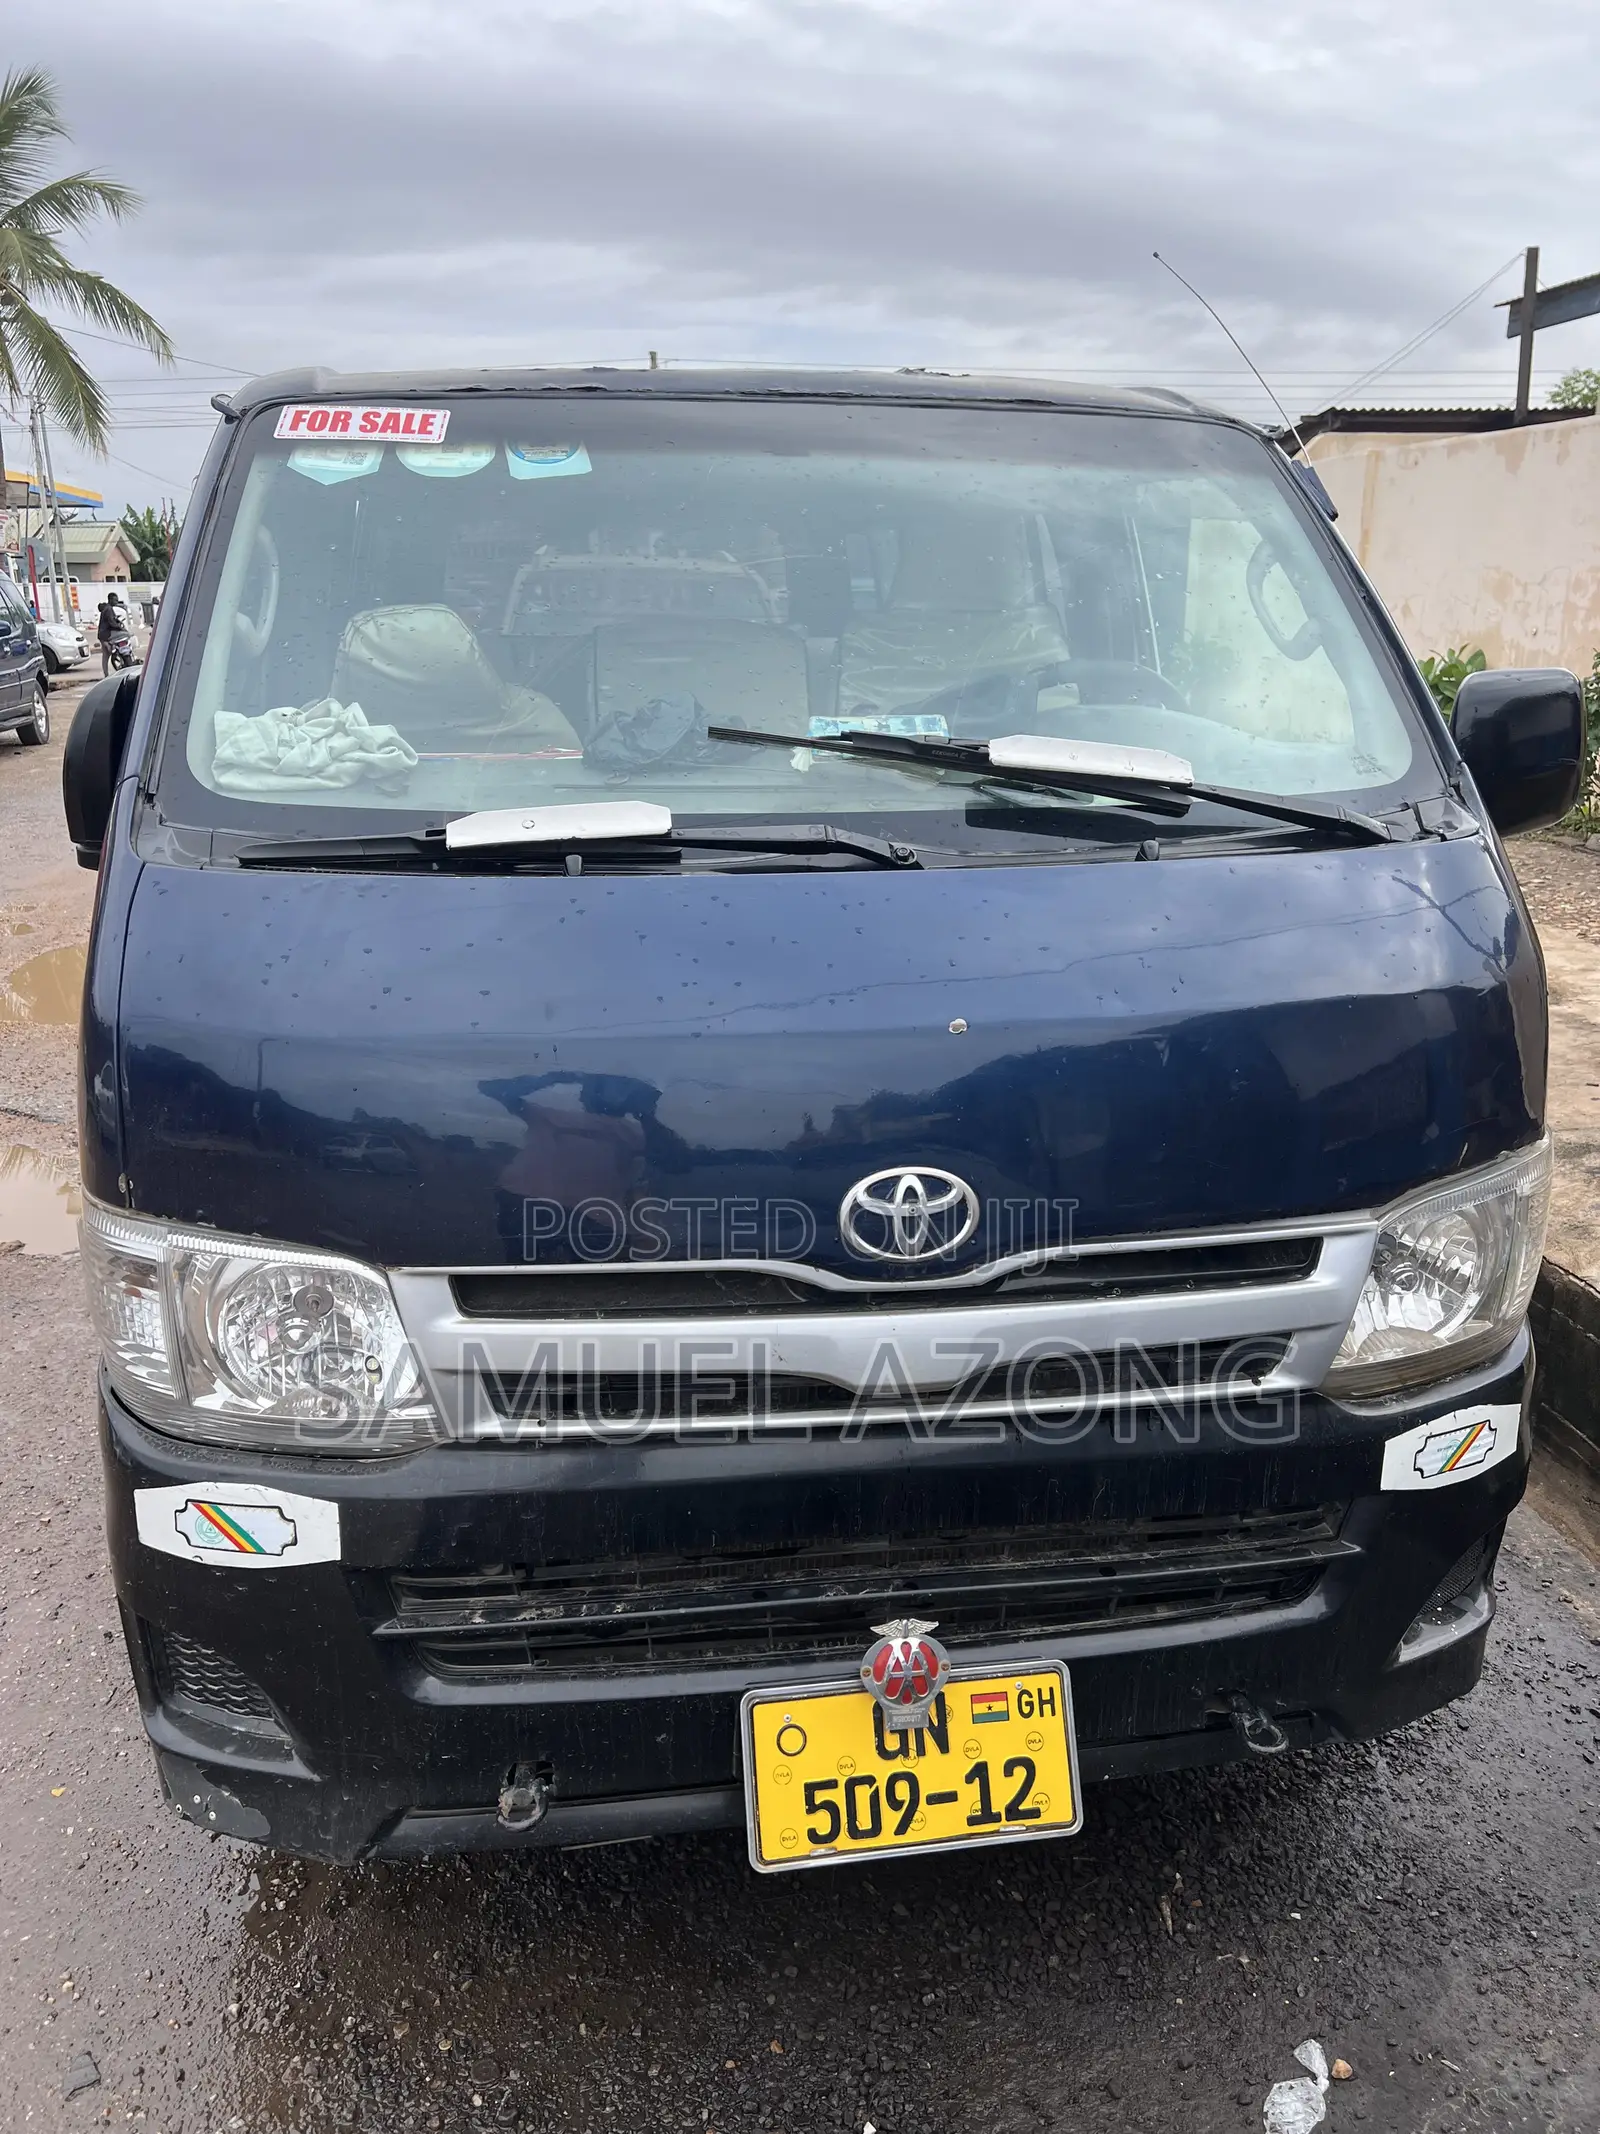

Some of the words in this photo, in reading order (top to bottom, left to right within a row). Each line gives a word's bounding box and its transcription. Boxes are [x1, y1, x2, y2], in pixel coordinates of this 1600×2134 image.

[289, 409, 352, 433] FOR
[359, 411, 437, 435] SALE
[1017, 1686, 1056, 1719] GH
[803, 1756, 1041, 1845] 509-12
